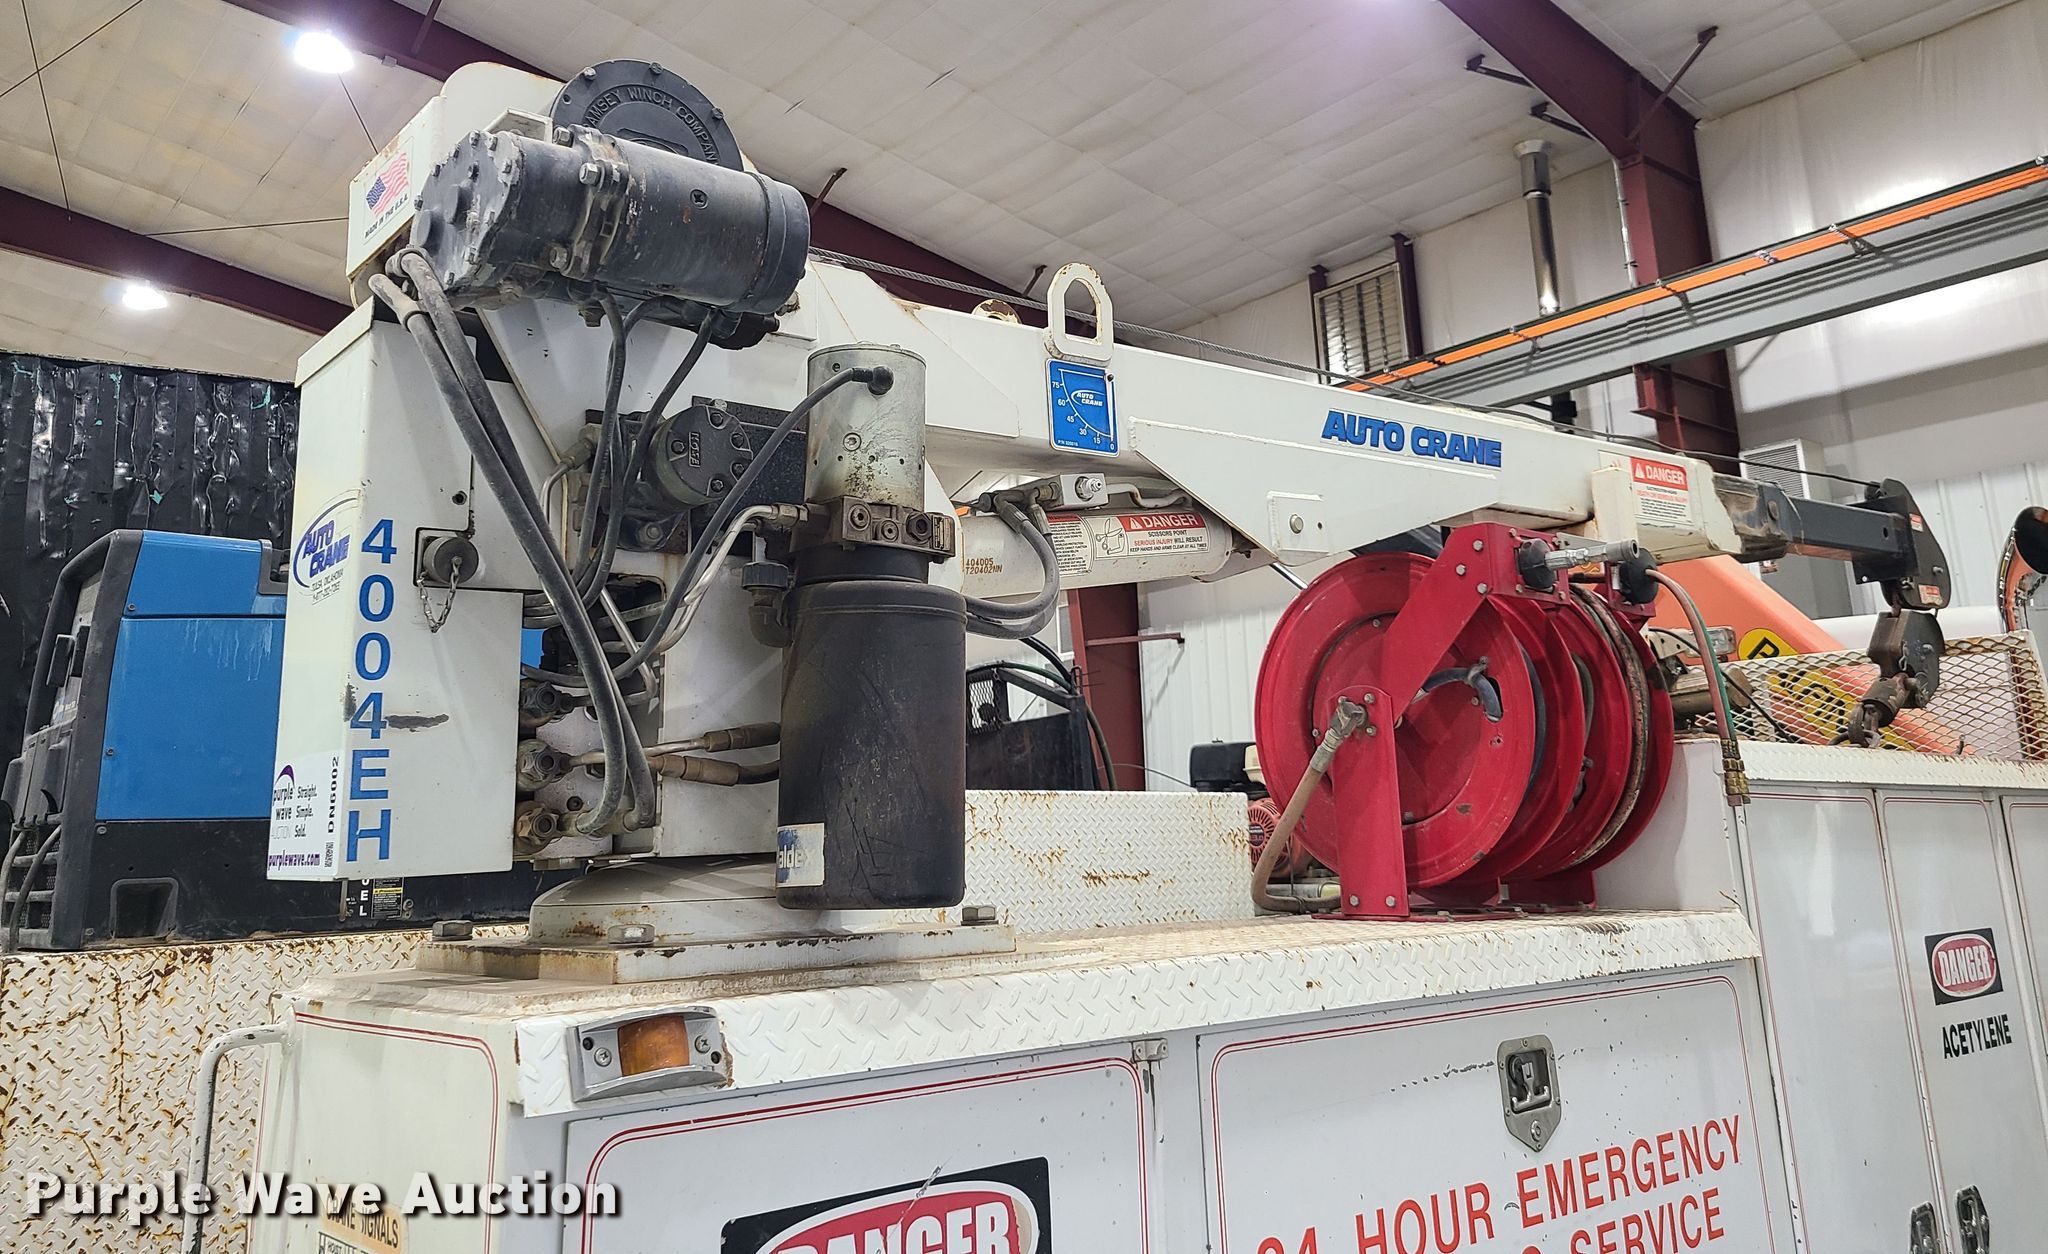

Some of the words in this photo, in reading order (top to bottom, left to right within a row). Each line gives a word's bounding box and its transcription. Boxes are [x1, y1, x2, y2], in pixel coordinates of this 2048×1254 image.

[583, 89, 622, 129] AMSEY
[627, 86, 673, 110] WINCH
[675, 105, 720, 165] COMPAN
[1057, 398, 1066, 407] 60
[1076, 392, 1094, 400] AUTO
[1066, 415, 1075, 423] 45
[1079, 428, 1087, 436] 30
[1321, 410, 1405, 452] AUTO
[1410, 426, 1502, 468] CRANE
[1645, 465, 1685, 485] DANGER
[1141, 514, 1198, 528] DANGER
[302, 520, 335, 560] AUTO
[1134, 539, 1155, 547] SERIOUS
[1156, 538, 1173, 546] INJURY
[1147, 530, 1172, 538] SCISSORS
[309, 533, 351, 578] CRANE
[346, 518, 397, 862] 4004EH
[272, 783, 294, 807] purple
[297, 784, 318, 802] Straight.
[327, 756, 340, 834] DN6002
[275, 806, 292, 821] wave
[267, 850, 321, 871] purplewave.com
[1937, 944, 1992, 987] DANGER
[1941, 1013, 2013, 1060] ACETYLENE
[1355, 1181, 1495, 1254] HOUR
[1516, 1114, 1739, 1229] EMERGENCY
[777, 1201, 1011, 1254] GER
